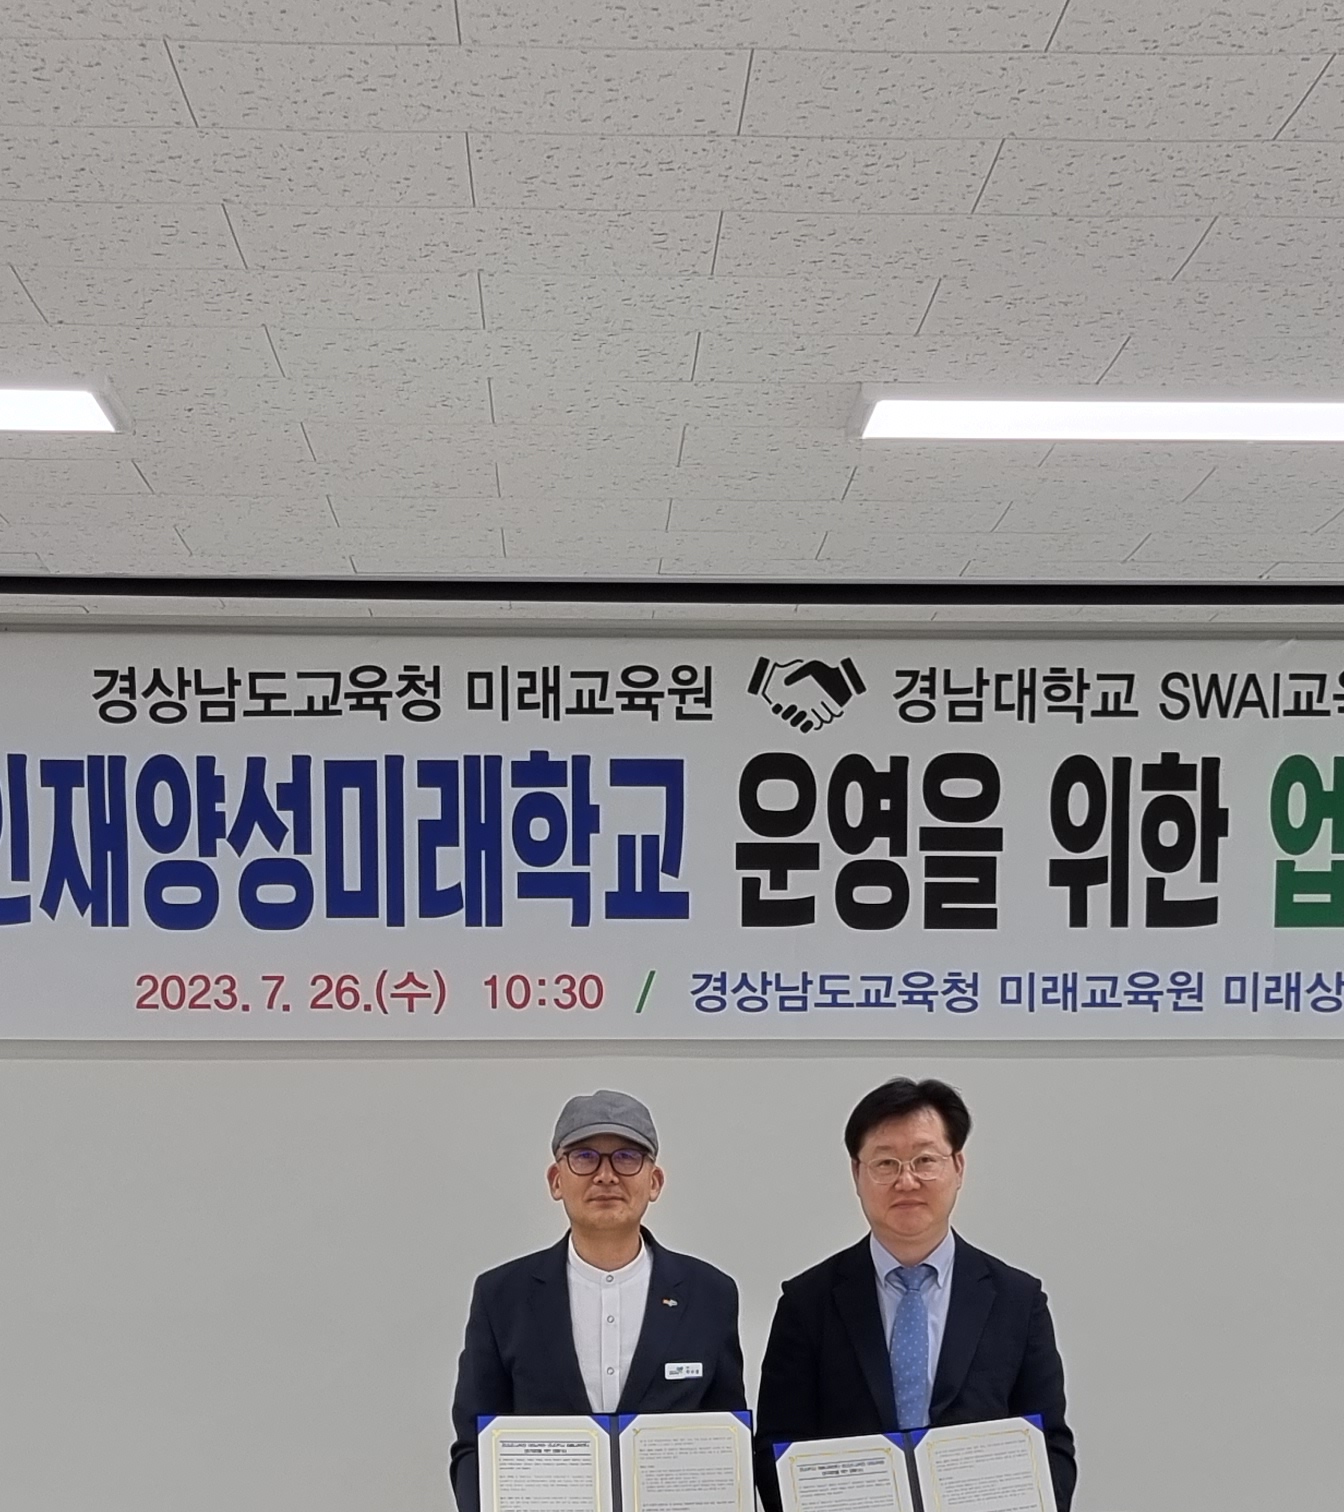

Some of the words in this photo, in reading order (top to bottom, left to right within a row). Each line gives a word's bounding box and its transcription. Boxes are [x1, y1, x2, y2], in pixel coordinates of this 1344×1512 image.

[90, 663, 443, 726] 경상남도교육청
[466, 663, 714, 723] 미래교육원
[891, 665, 1140, 726] 경남대학교
[734, 751, 1005, 932] 운영을
[1047, 750, 1231, 930] 위한
[483, 972, 605, 1011] 10:30
[689, 970, 980, 1015] 경상남도교육청
[999, 970, 1205, 1014] 미래교육원
